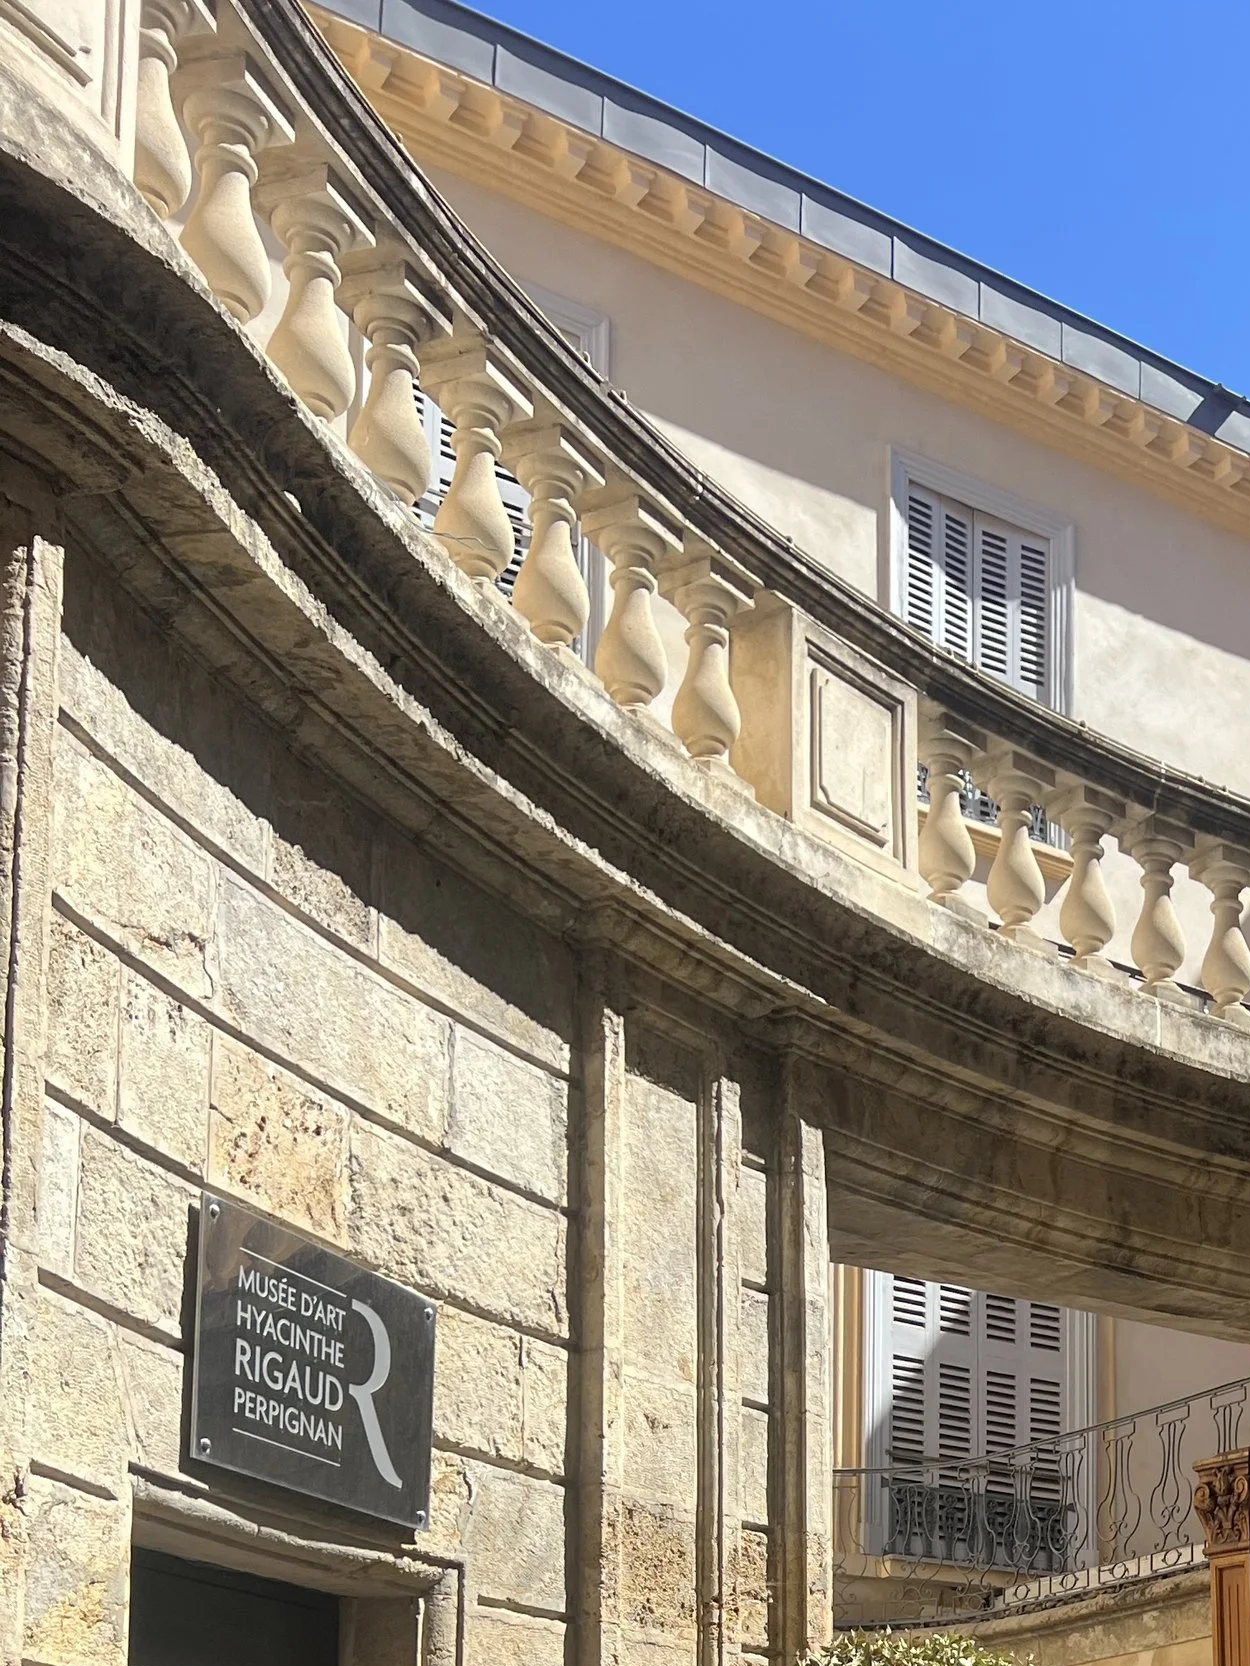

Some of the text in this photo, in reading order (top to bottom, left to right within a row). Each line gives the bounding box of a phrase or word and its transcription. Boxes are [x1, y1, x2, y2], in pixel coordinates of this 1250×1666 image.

[238, 1265, 346, 1331] MUSÉE D'ART
[236, 1300, 345, 1369] HYACINTHE
[234, 1337, 344, 1412] RIGAUD
[233, 1387, 342, 1450] PERPIGNAN
